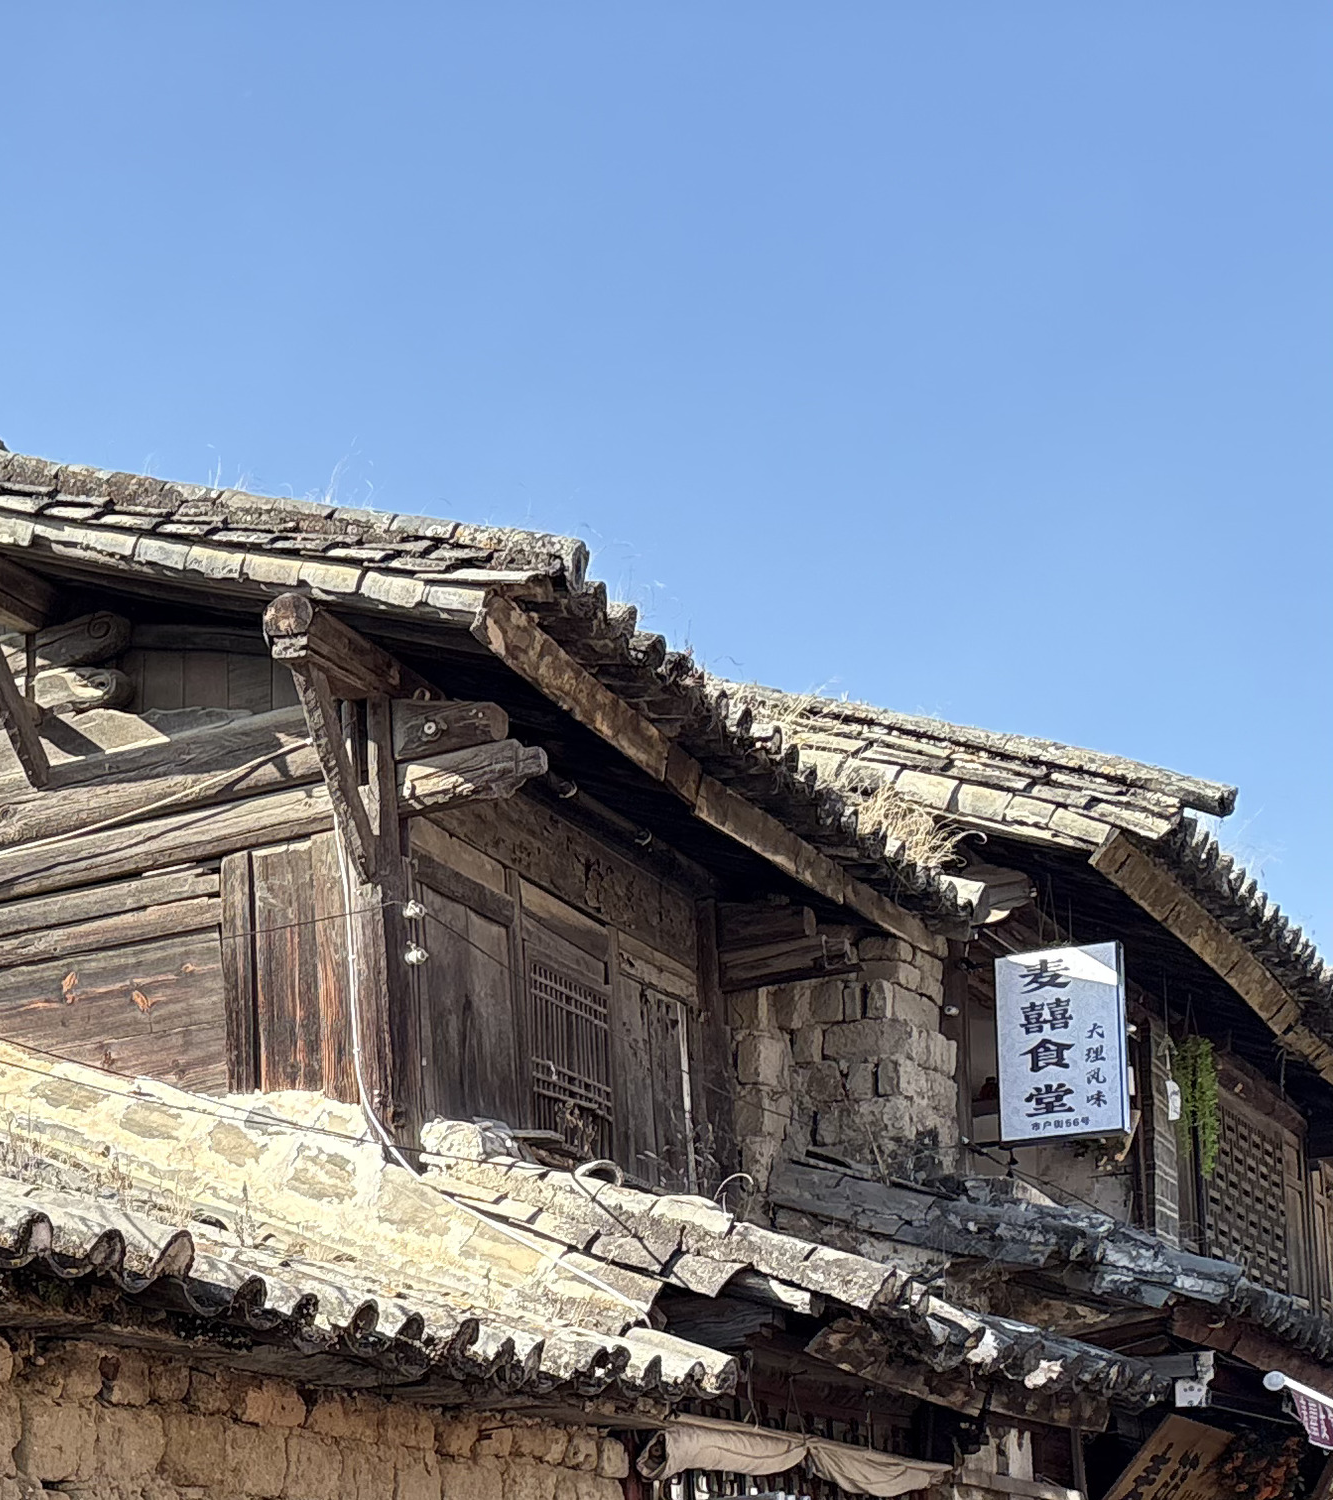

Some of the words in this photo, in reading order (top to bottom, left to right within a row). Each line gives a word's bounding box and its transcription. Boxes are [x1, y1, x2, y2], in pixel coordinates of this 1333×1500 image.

[1018, 958, 1076, 1118] 麦囍食堂
[1084, 1022, 1108, 1109] 大理风味
